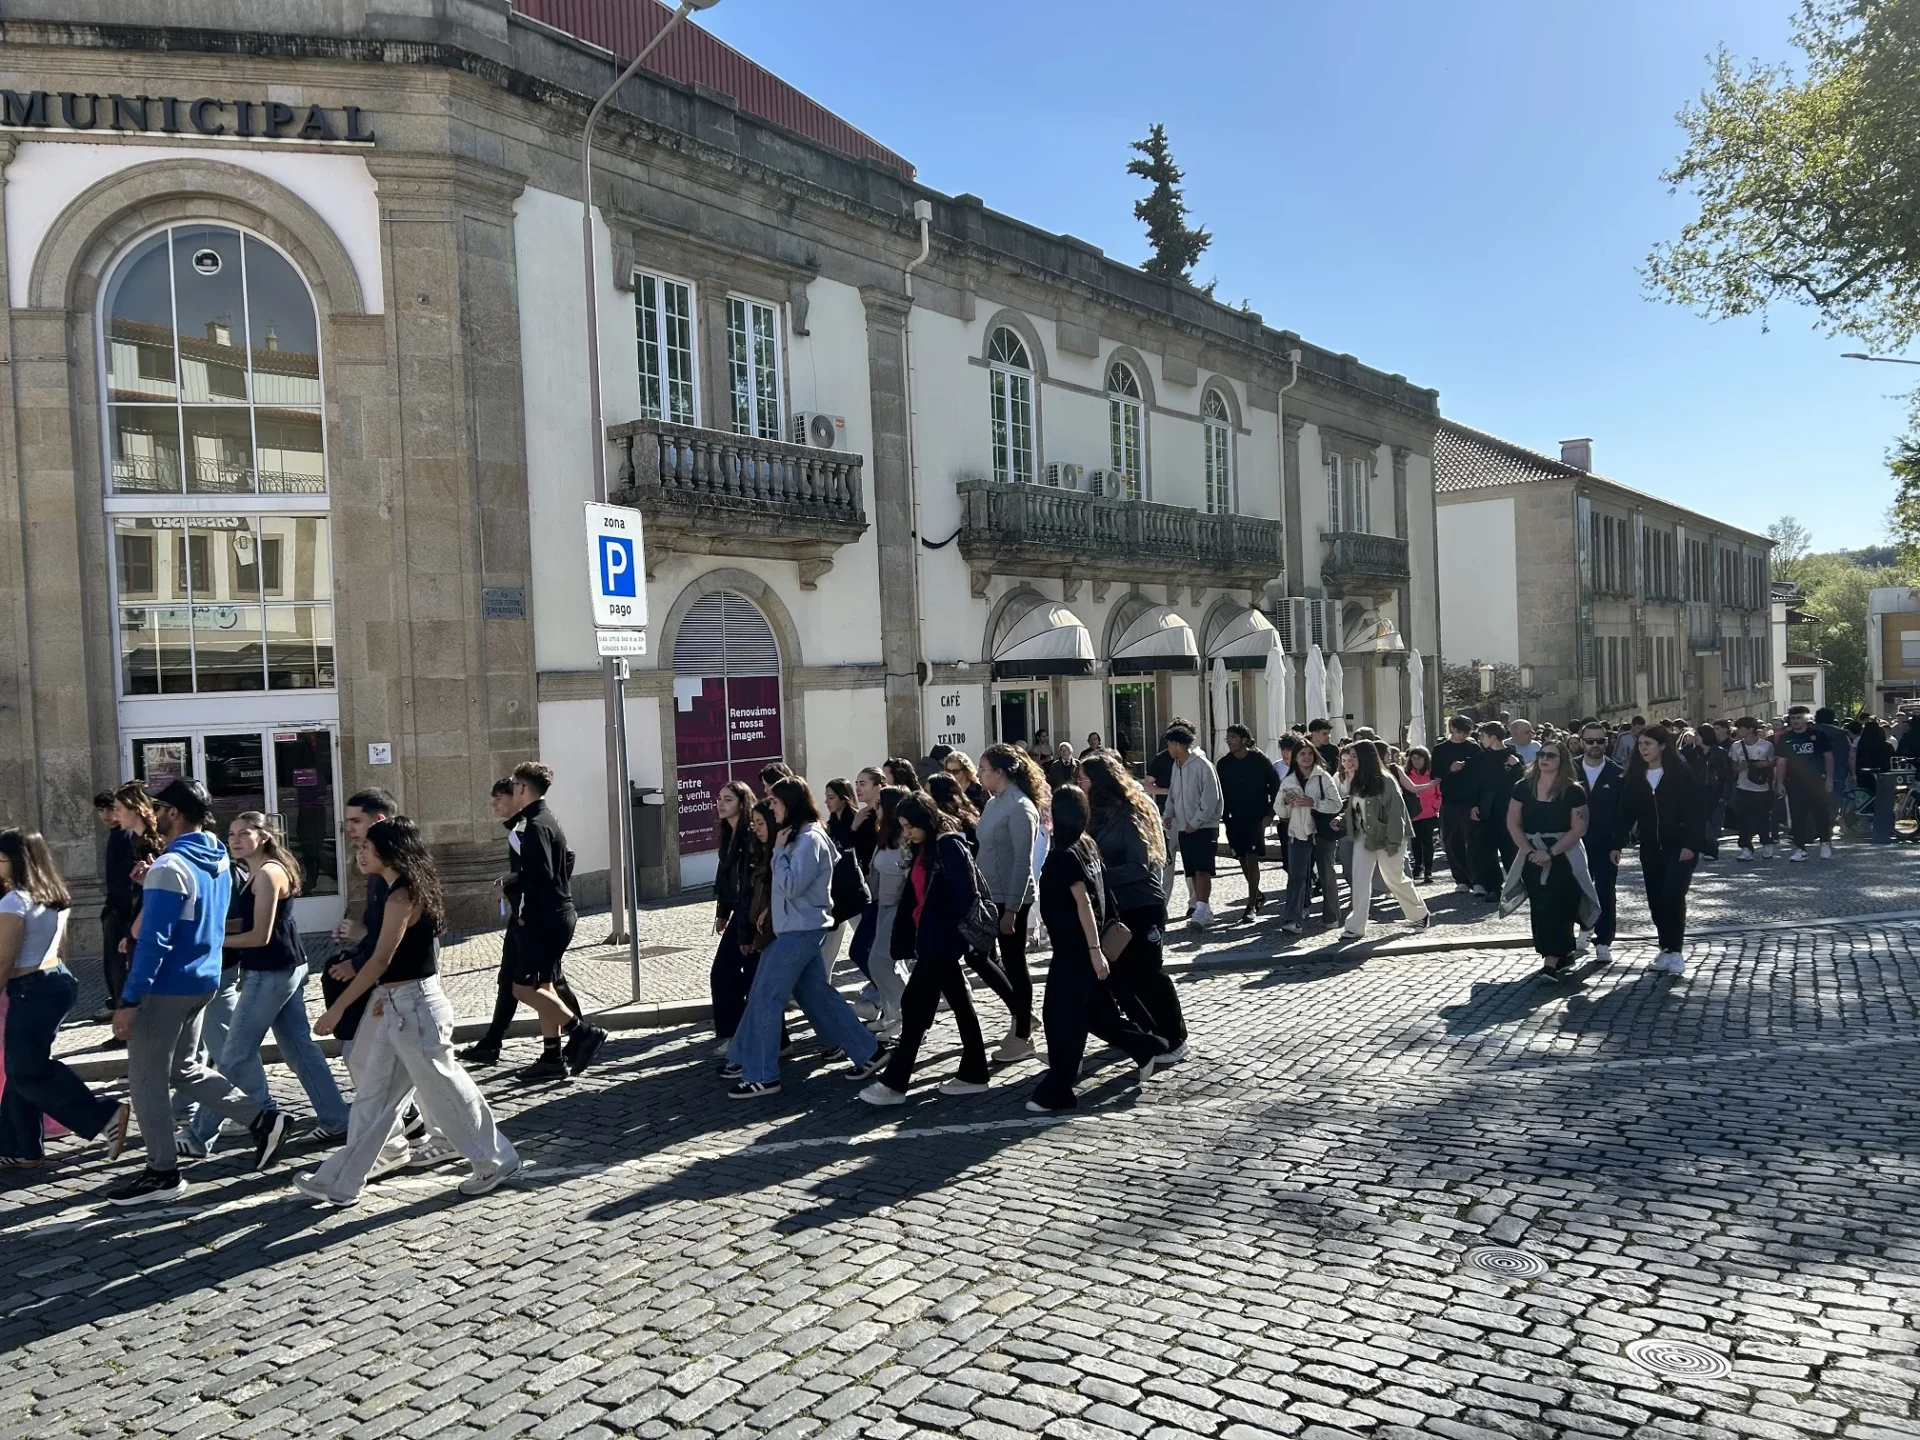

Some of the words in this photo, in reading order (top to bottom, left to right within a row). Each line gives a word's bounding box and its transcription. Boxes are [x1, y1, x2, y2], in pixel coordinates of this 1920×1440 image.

[0, 88, 375, 142] MUNICIPAL
[603, 517, 626, 529] zona
[606, 541, 628, 591] P
[609, 603, 632, 616] pago
[941, 691, 961, 707] CAFÉ
[730, 705, 776, 718] Renovámos
[730, 720, 737, 729] a
[739, 719, 764, 729] nossa
[946, 714, 956, 727] DO
[731, 730, 766, 742] imagem.
[937, 732, 966, 745] TEATRO
[677, 779, 702, 789] Entre
[677, 794, 683, 802] e
[686, 790, 711, 801] venha
